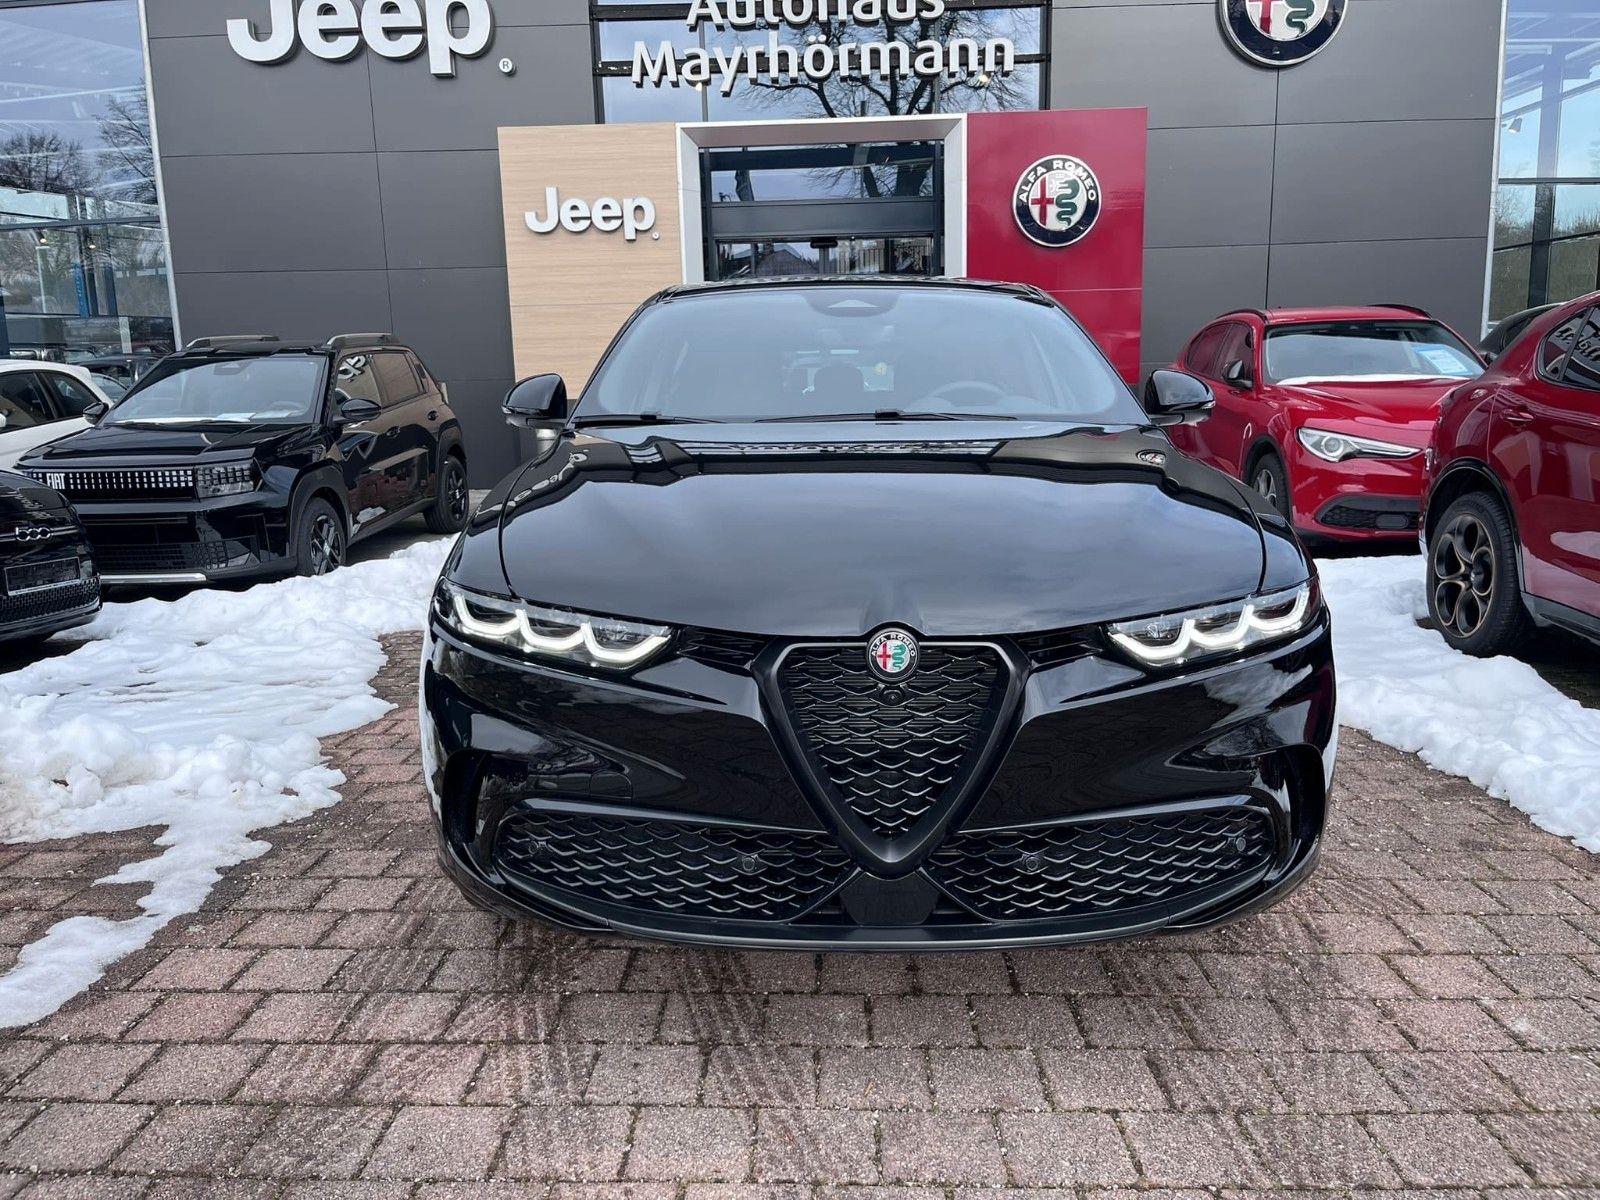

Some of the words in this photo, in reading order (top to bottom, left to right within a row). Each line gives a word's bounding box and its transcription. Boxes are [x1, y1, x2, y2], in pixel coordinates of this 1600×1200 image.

[226, 0, 492, 76] Jeep
[631, 30, 1015, 94] Mayrhörmann
[1019, 165, 1048, 203] ALFA
[1052, 160, 1097, 201] ROMEO
[524, 186, 656, 241] Jeep
[46, 473, 66, 490] FIAT
[15, 527, 51, 542] 500
[872, 636, 888, 657] ALFA
[890, 633, 916, 657] ROMEO
